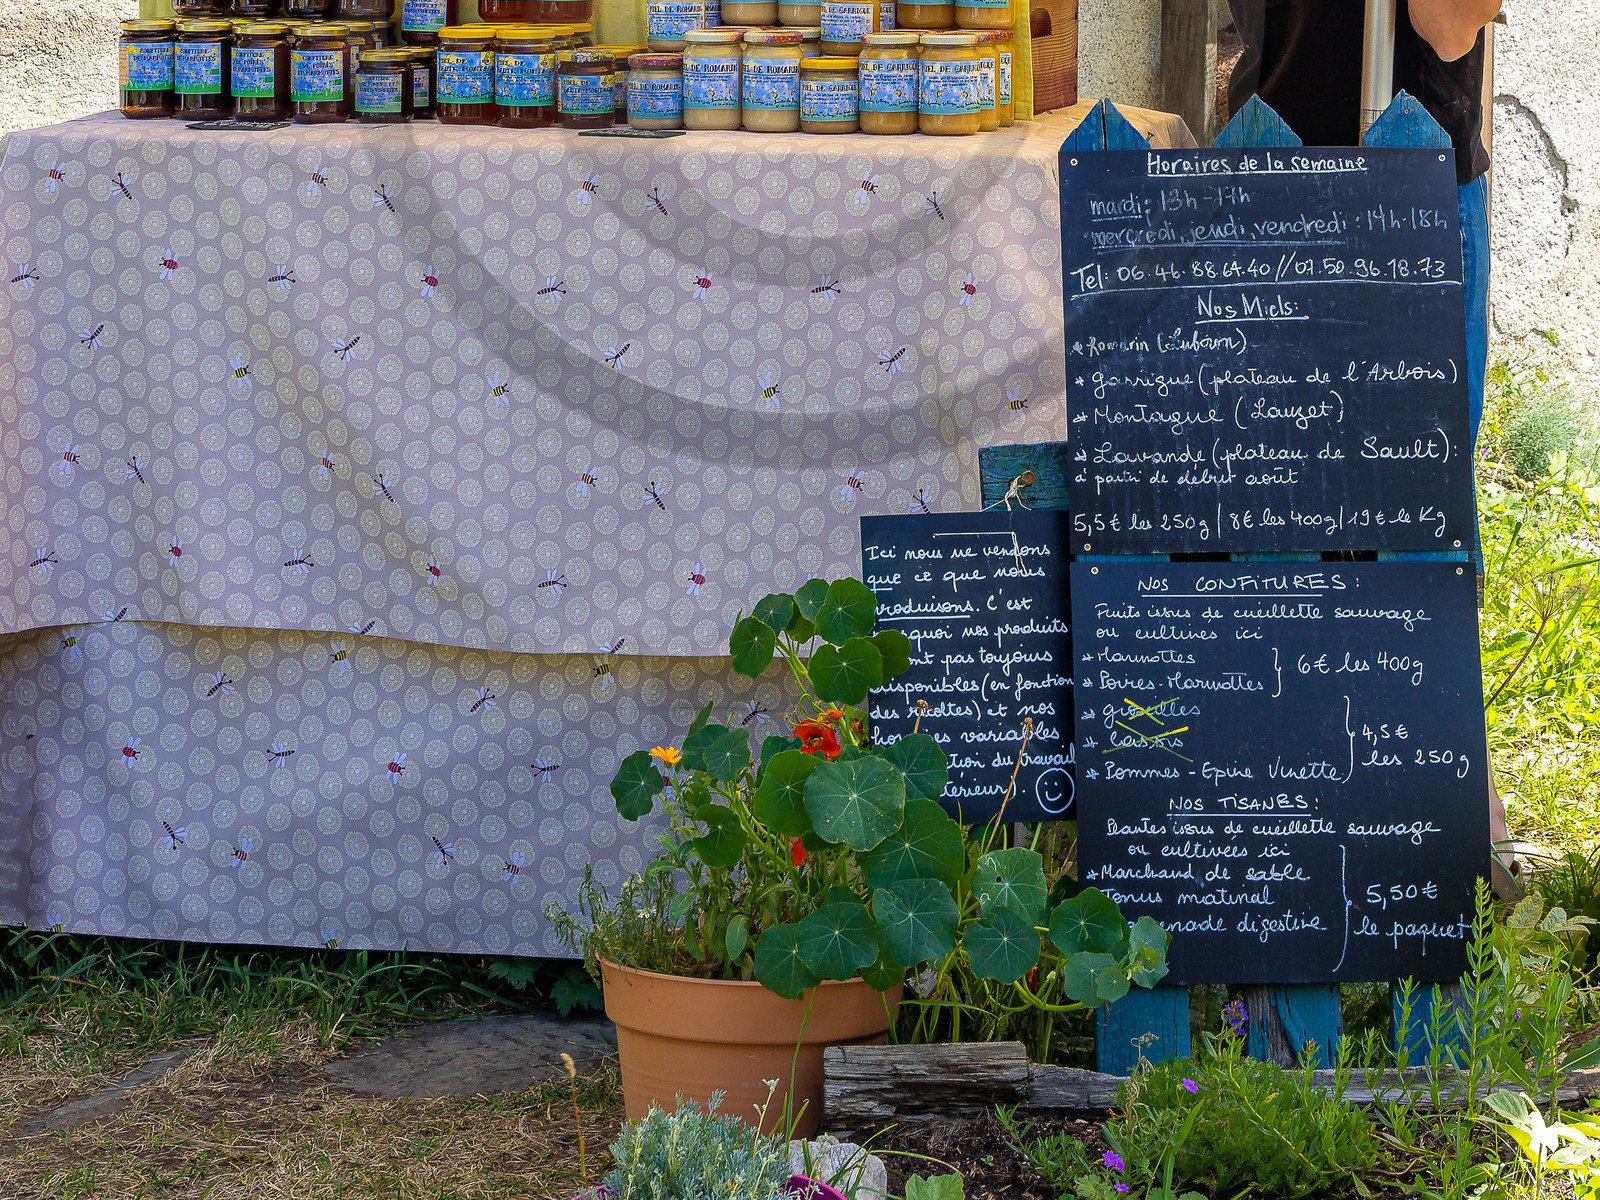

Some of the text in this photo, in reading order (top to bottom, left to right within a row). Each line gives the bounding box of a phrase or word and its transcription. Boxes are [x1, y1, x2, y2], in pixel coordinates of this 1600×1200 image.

[1147, 151, 1369, 173] Horaires de la semaine
[1073, 264, 1109, 292] Tel:
[1197, 289, 1299, 318] Nos Miels:
[1086, 335, 1150, 357] Romarin
[1198, 362, 1297, 396] (plateau
[1305, 366, 1331, 386] de
[1094, 403, 1224, 435] Montagne
[1094, 441, 1206, 466] Lavande
[1212, 437, 1309, 472] (plateau
[1316, 441, 1345, 460] de
[1149, 470, 1169, 484] de
[1127, 511, 1153, 531] les
[1160, 513, 1210, 541] 250g
[1229, 513, 1254, 530] 8€
[1258, 507, 1286, 528] les
[1289, 508, 1339, 536] 400g
[1388, 508, 1412, 524] le
[1418, 505, 1447, 538] Kg
[865, 544, 1051, 561] Ici nous ne vendons
[866, 566, 1046, 593] que ce que nous
[1137, 579, 1170, 592] NOS
[1094, 602, 1432, 632] Fruits issus de cueillette sauvage
[962, 616, 1069, 649] nos produits
[1096, 625, 1119, 640] ou
[1235, 625, 1263, 640] ici
[908, 644, 1054, 677] ont pas toujours
[1097, 647, 1196, 665] Marmottes
[1335, 650, 1371, 673] les
[1376, 650, 1424, 685] 400g
[981, 672, 1011, 702] (en
[1015, 673, 1075, 702] fonction
[869, 704, 900, 719] des
[987, 705, 1009, 717] et
[1016, 701, 1056, 715] nos
[960, 721, 1061, 743] variables
[991, 751, 1014, 766] du
[1019, 742, 1076, 766] travail
[1362, 749, 1403, 767] les
[1105, 756, 1345, 787] Pommes Epine Vinette
[1168, 796, 1204, 811] NOS
[1106, 817, 1442, 845] Plantes issus de cueillette sauvage
[1127, 844, 1151, 856] ou
[1258, 841, 1290, 857] ici
[1101, 863, 1310, 882] Marchand de sable
[1177, 884, 1275, 906] matinal
[1236, 909, 1328, 943] digestive
[1353, 914, 1473, 956] le paquet
